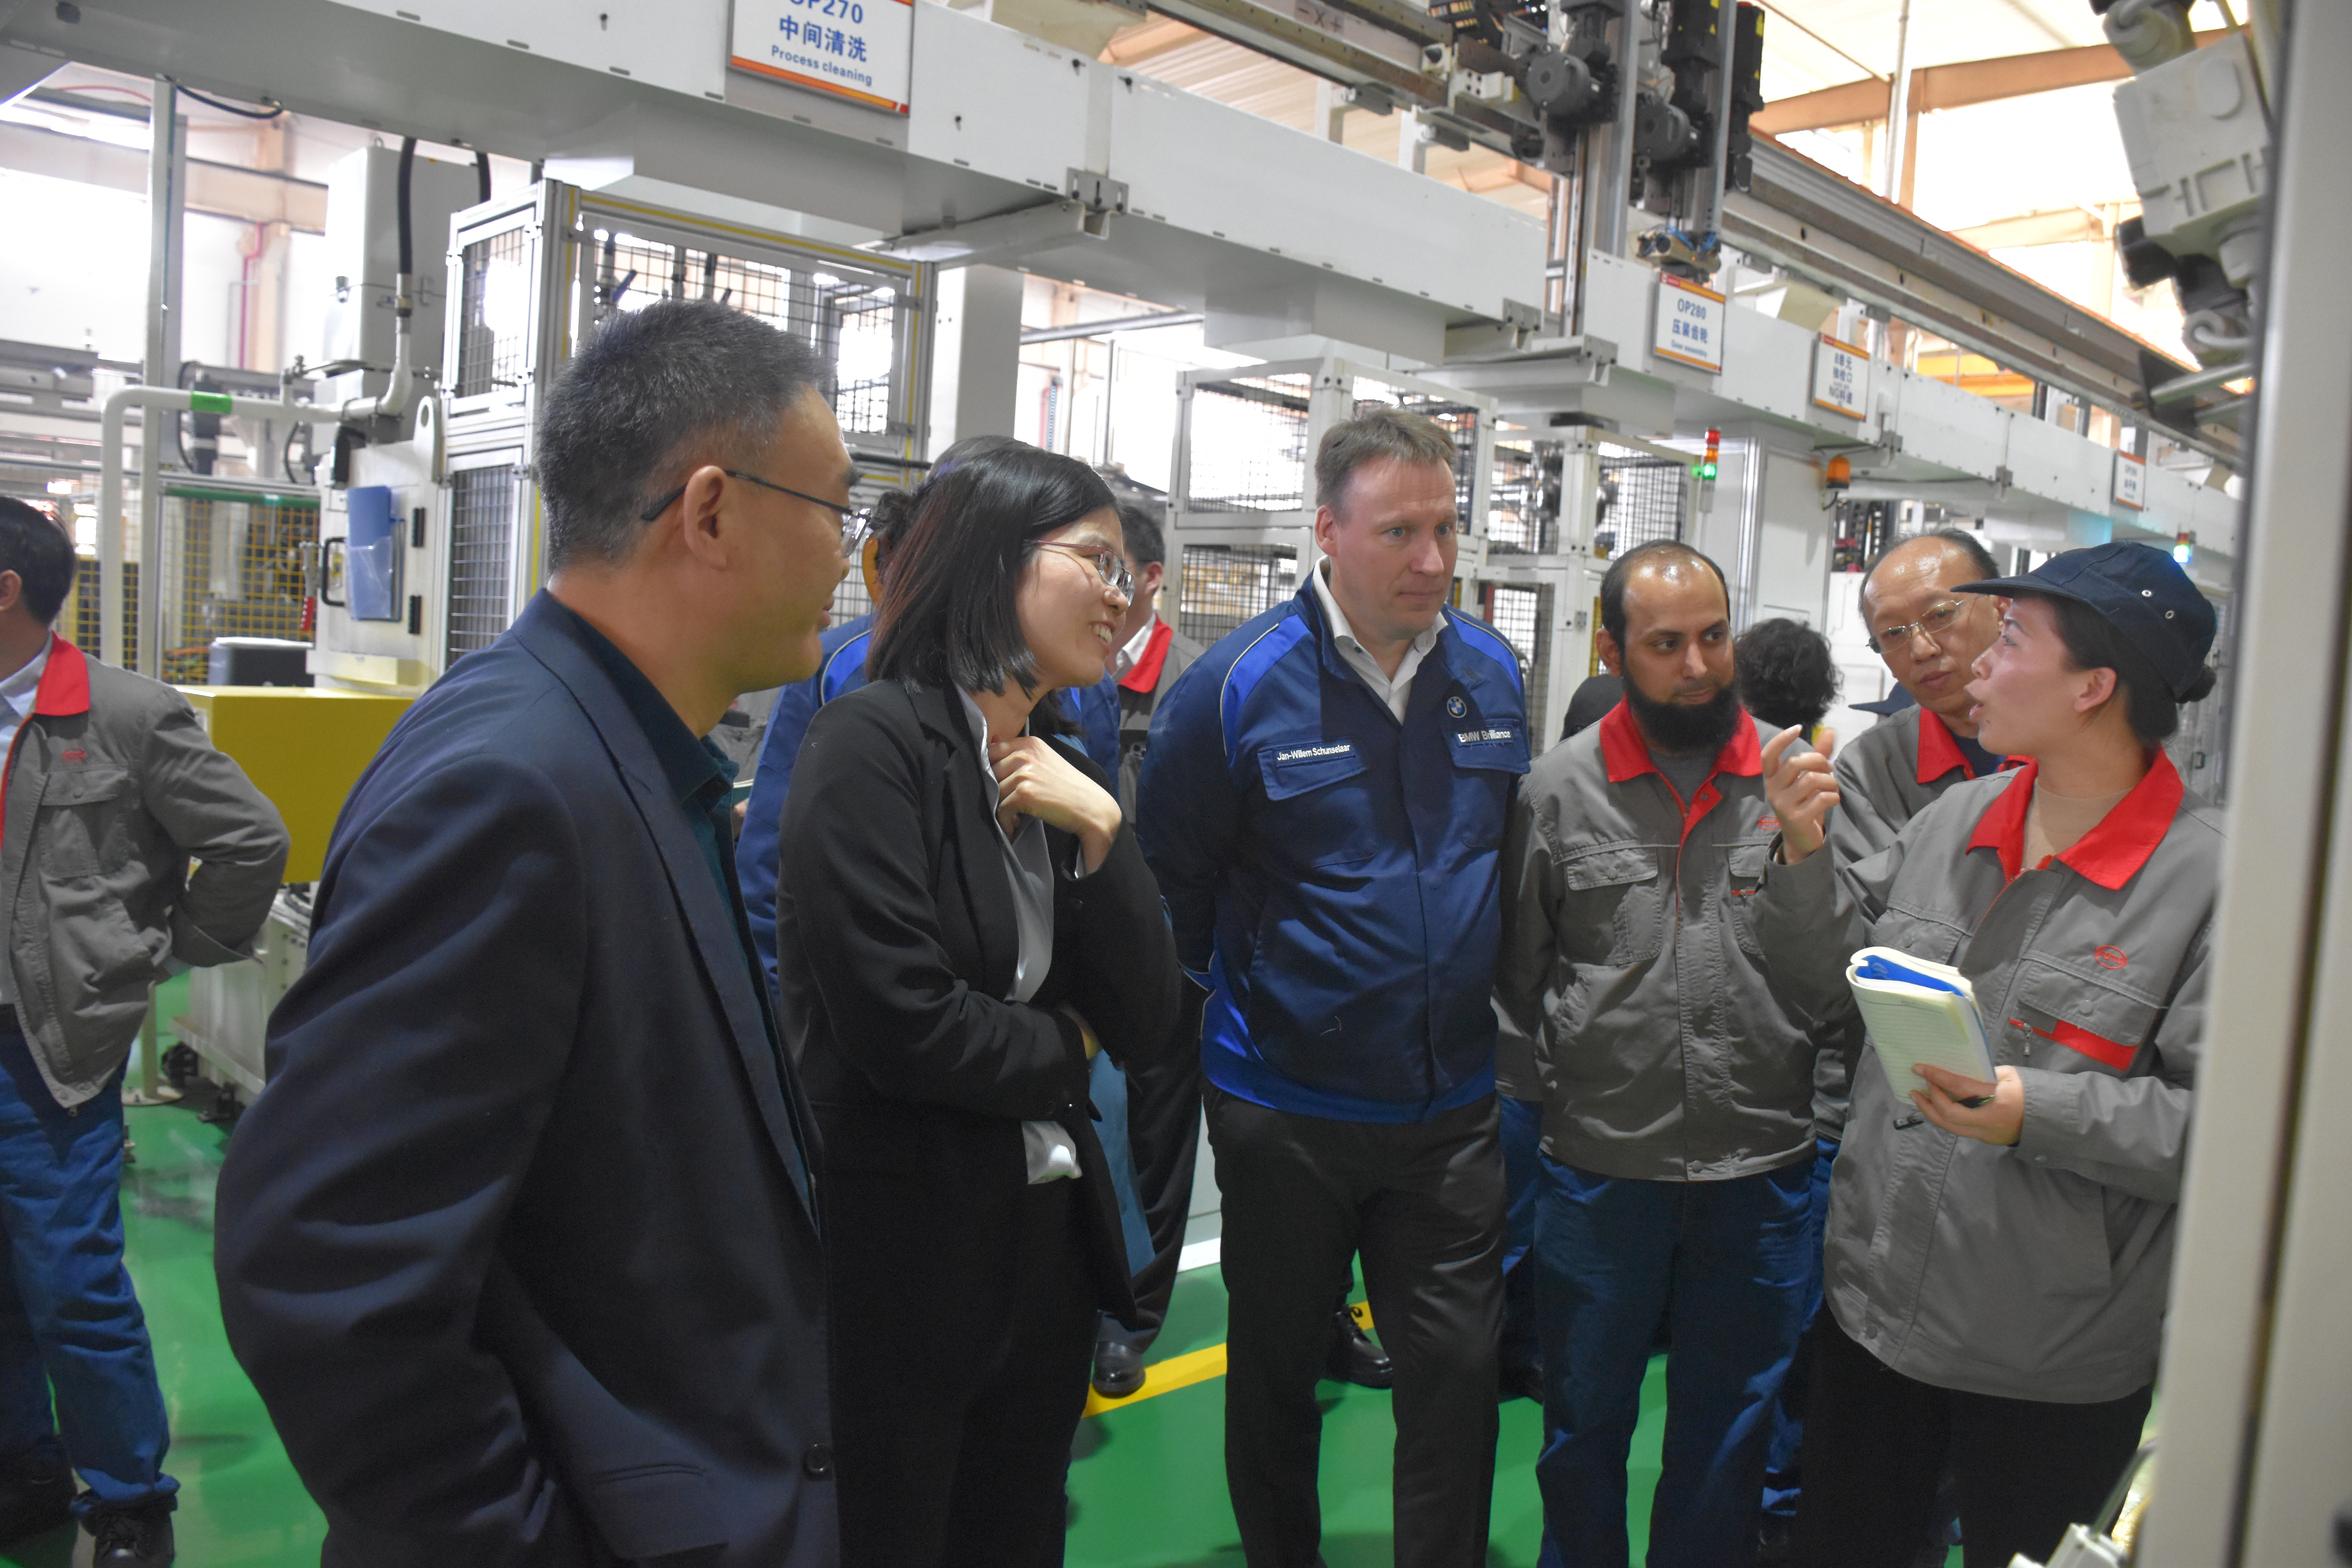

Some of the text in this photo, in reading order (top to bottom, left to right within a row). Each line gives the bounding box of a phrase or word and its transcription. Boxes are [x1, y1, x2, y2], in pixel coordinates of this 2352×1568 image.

[789, 0, 863, 24] 270
[779, 15, 867, 62] 中间清洗
[771, 45, 873, 86] Process cleaning
[1677, 298, 1707, 320] OP280
[1458, 730, 1511, 742] BMW Brilliance
[1277, 744, 1350, 761] Jan-Willem Schunselaar
